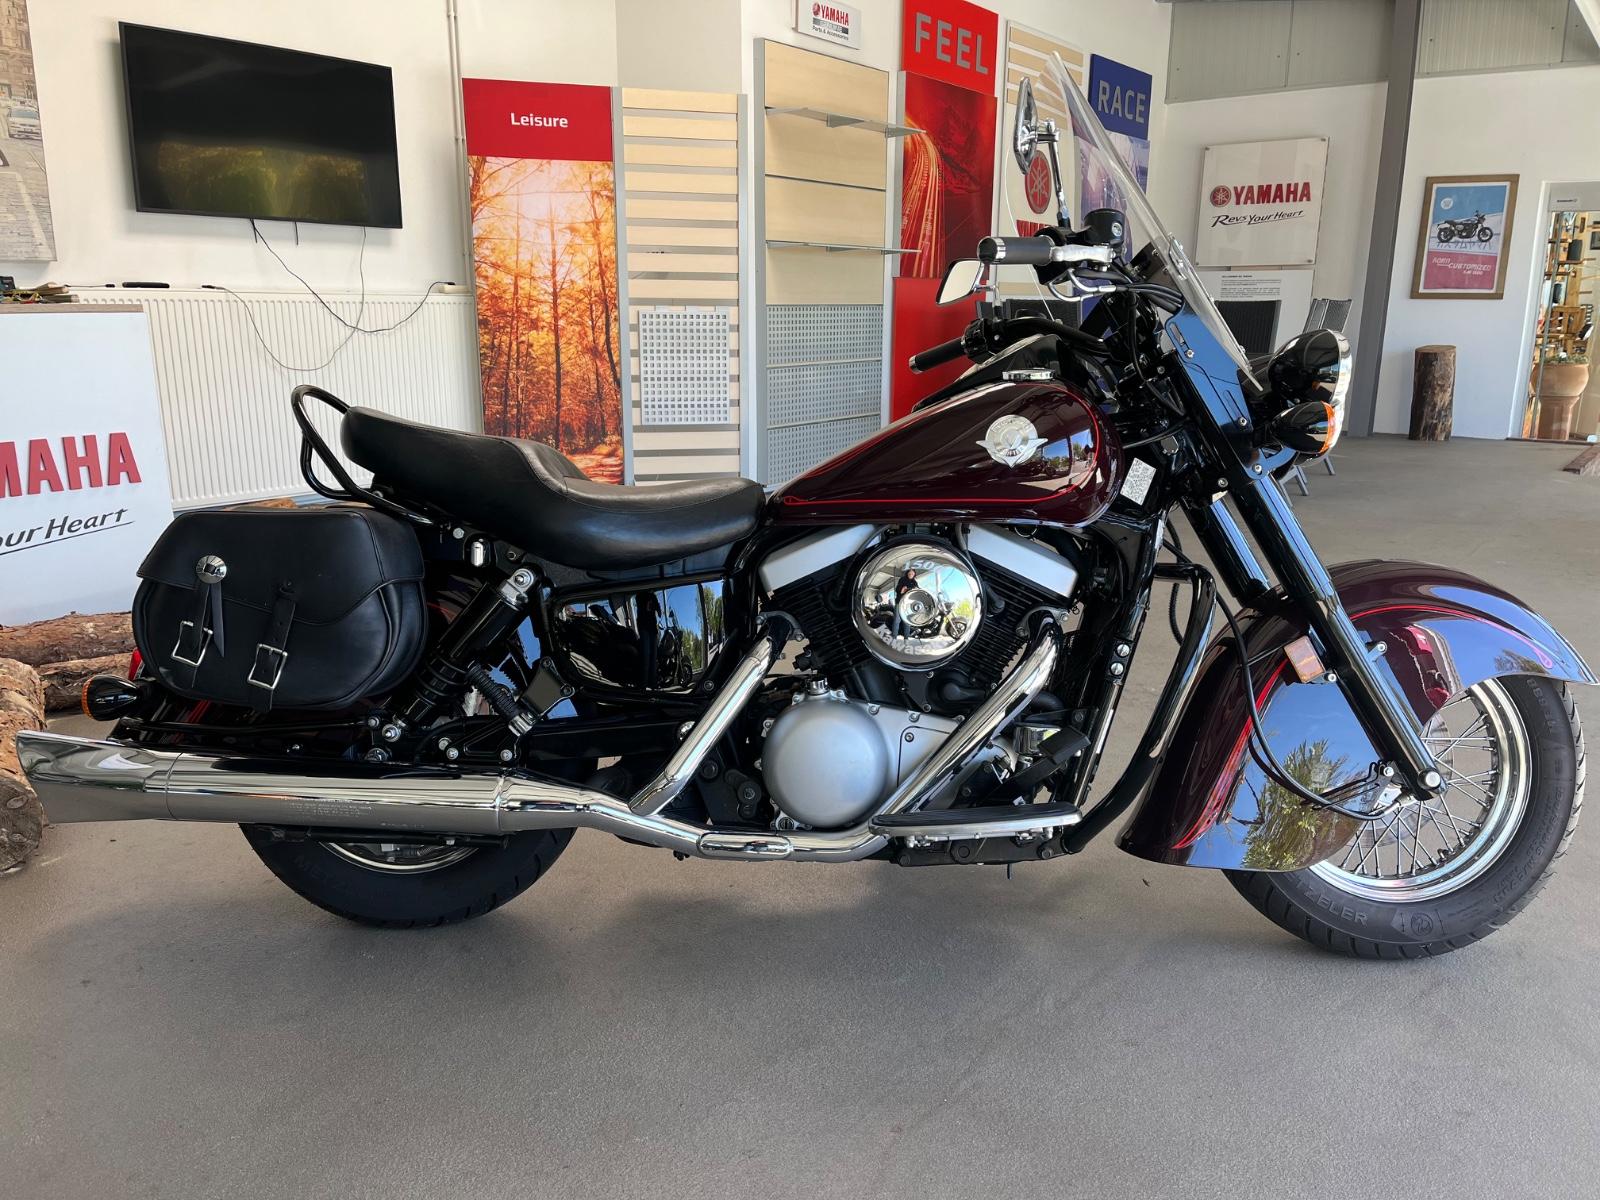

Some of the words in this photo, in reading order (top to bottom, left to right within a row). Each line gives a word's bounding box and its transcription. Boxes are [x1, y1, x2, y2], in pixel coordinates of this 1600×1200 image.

[821, 5, 849, 26] YAMAHA
[915, 12, 988, 75] FEEL
[1098, 79, 1146, 124] RACE
[510, 112, 569, 128] Leisure
[1233, 182, 1312, 206] YAMAHA
[1210, 214, 1247, 228] Revs
[1247, 214, 1275, 226] Your
[1274, 210, 1304, 220] Heart
[0, 526, 43, 549] ur
[44, 508, 128, 540] Heart
[1282, 871, 1369, 929] ETZELER
